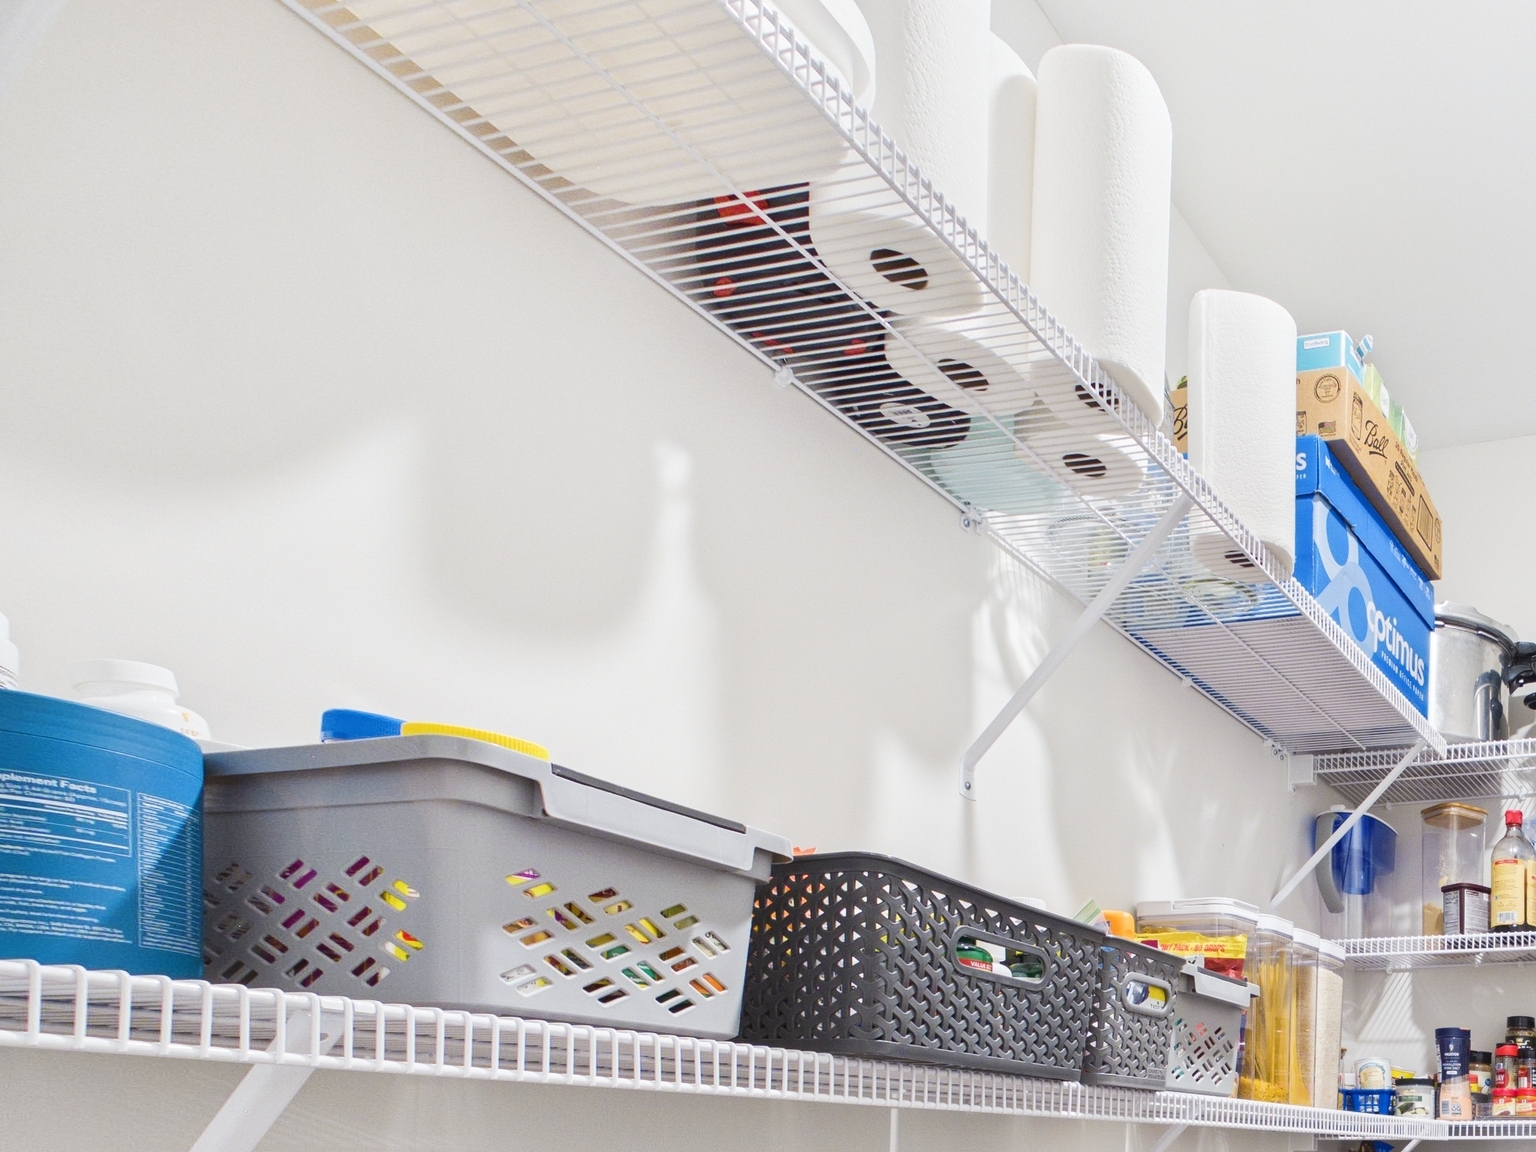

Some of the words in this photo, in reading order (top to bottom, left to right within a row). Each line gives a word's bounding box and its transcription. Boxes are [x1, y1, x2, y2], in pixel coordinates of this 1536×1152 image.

[1364, 420, 1389, 458] Ball
[1367, 601, 1425, 687] optimus
[60, 780, 97, 793] Facts
[1176, 943, 1191, 951] PACK
[1204, 944, 1225, 952] DROPS
